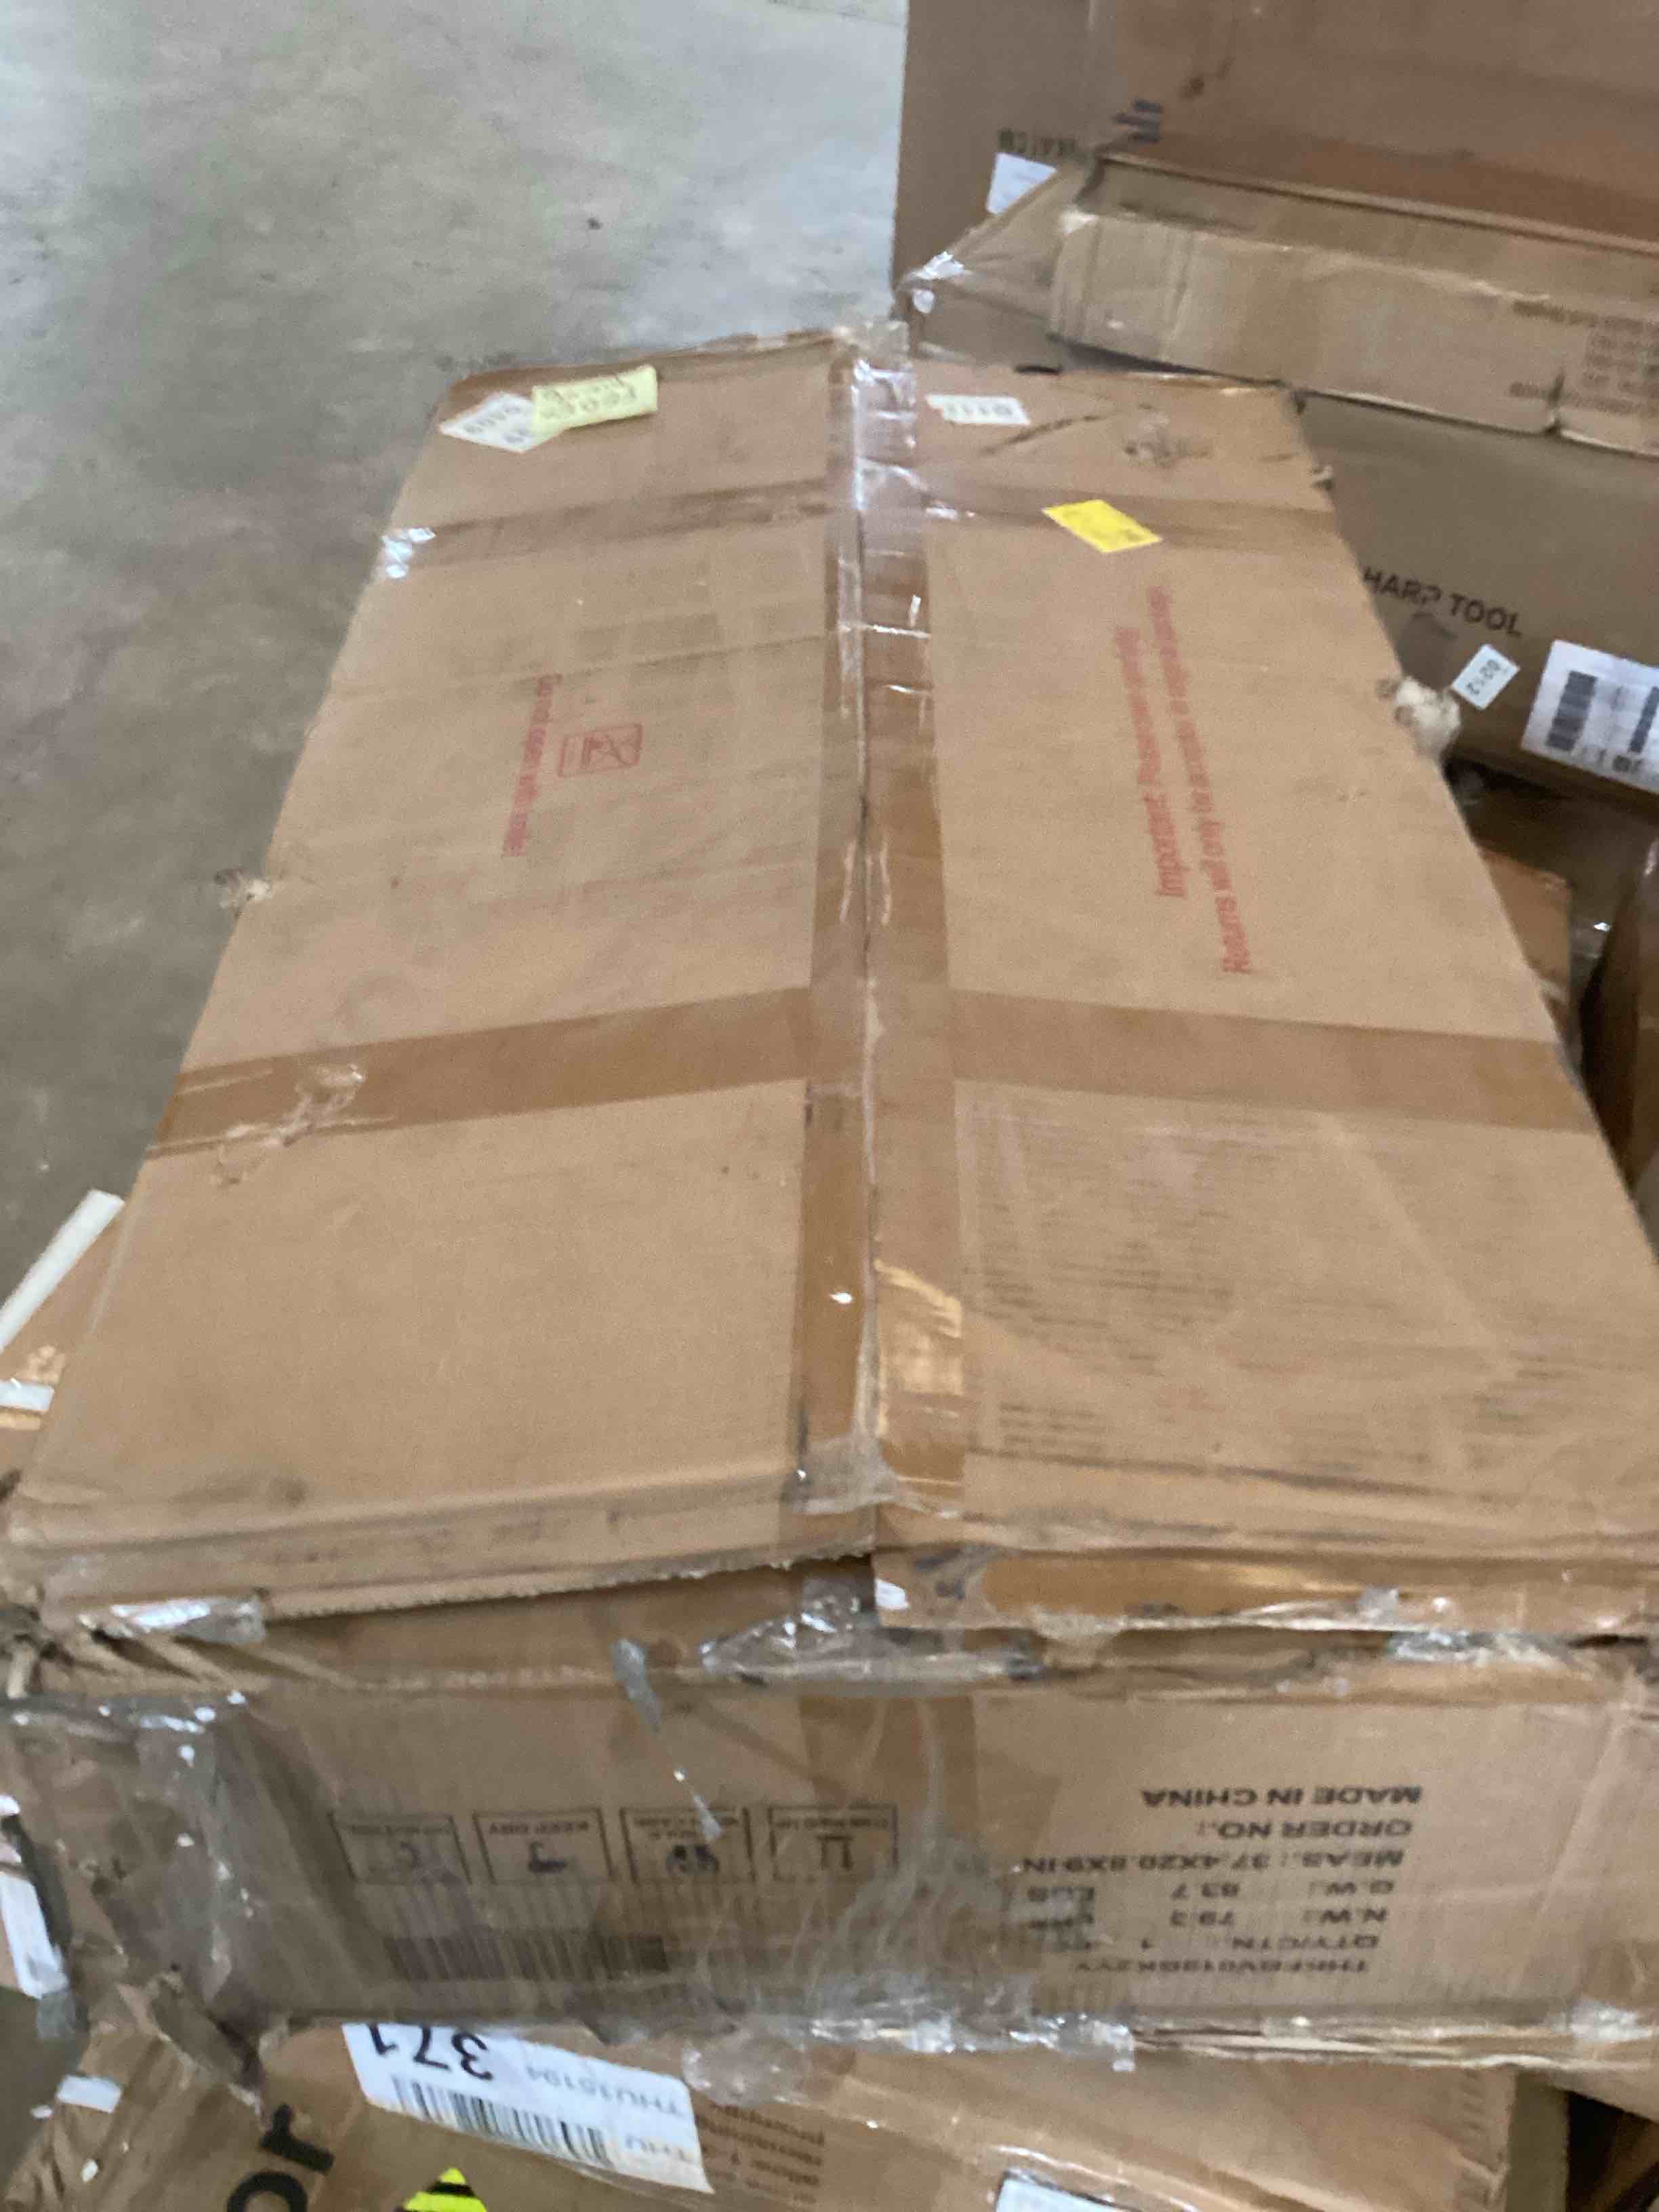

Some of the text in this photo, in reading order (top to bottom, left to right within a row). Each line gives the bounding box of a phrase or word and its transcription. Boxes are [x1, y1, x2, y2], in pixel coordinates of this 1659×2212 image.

[1450, 592, 1522, 638] TOOL
[1141, 1785, 1422, 1807] MADE IN CHINA
[1282, 1820, 1414, 1839] ORDER
[367, 2024, 494, 2081] 371
